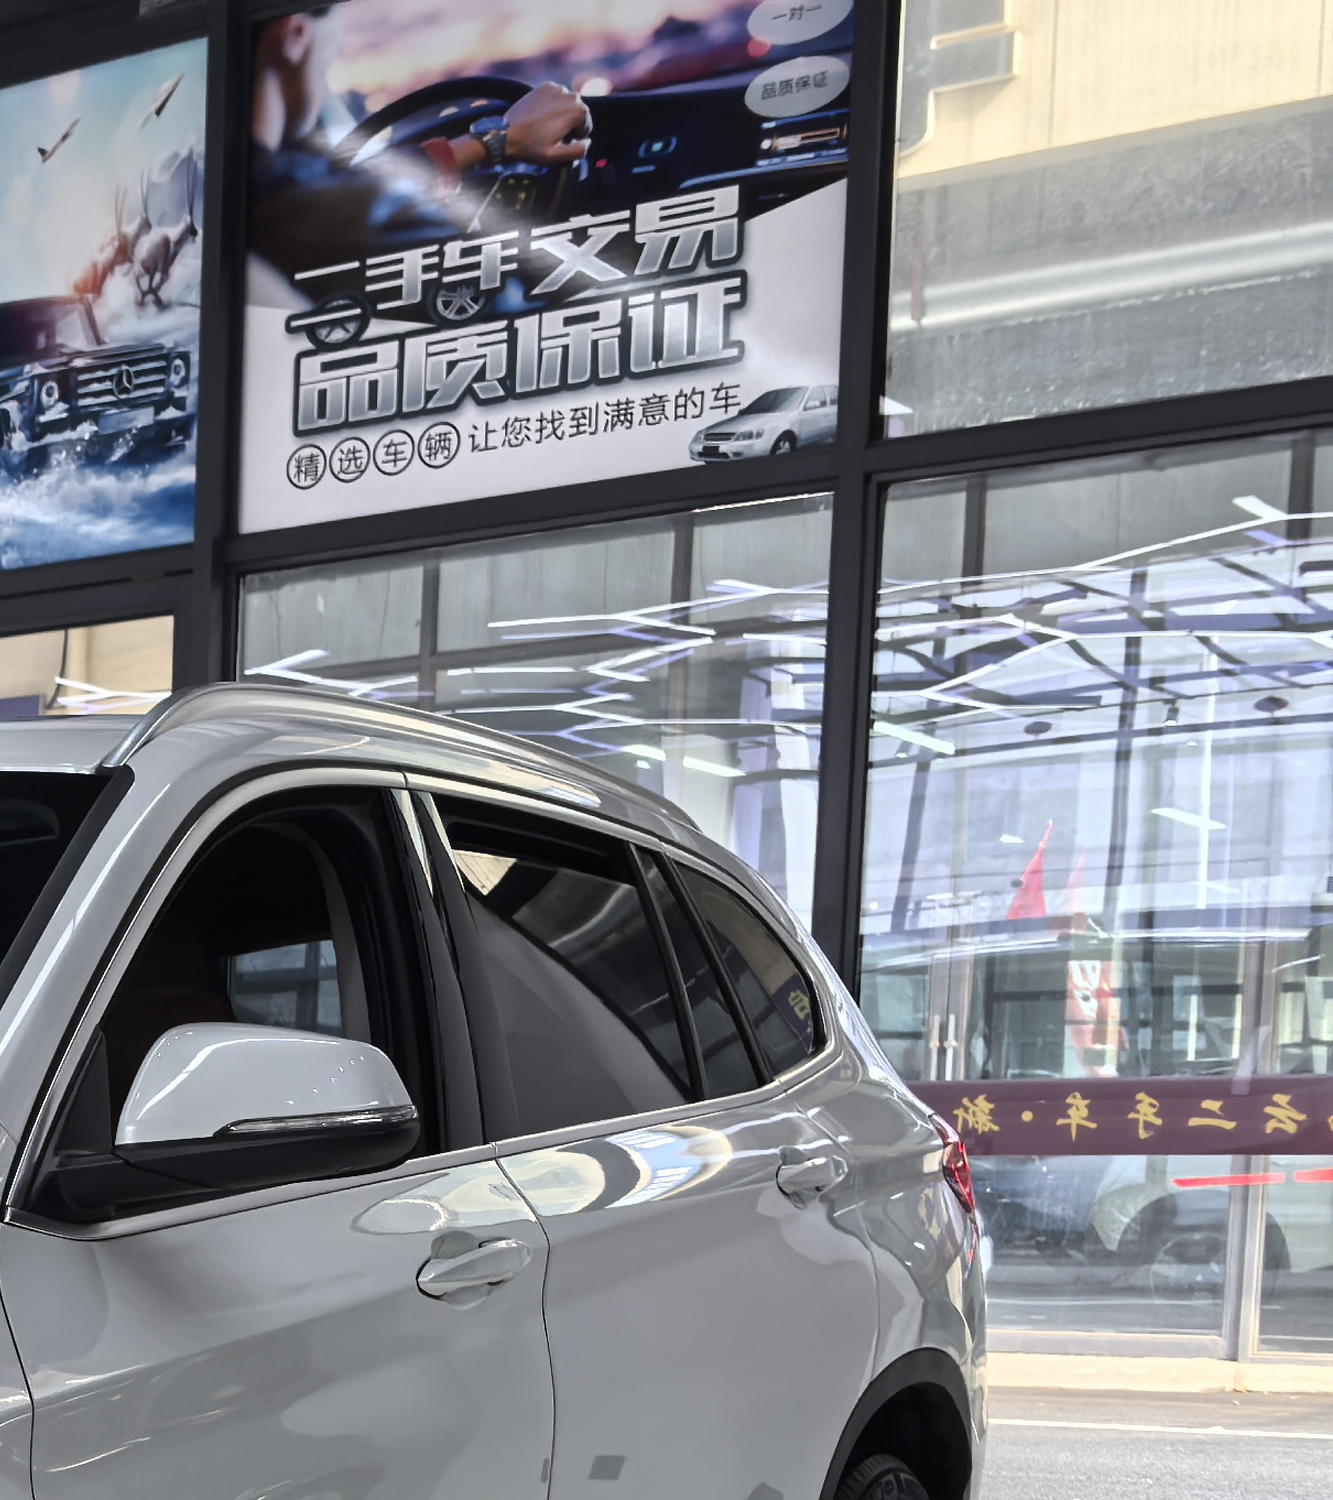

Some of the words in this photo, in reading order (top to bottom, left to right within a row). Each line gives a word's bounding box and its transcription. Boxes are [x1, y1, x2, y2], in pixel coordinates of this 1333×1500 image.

[760, 69, 829, 101] 品质保证
[289, 185, 742, 330] 二手车交易
[296, 277, 744, 433] 品质保证
[287, 420, 461, 490] 精选车辆
[468, 380, 742, 456] 让您找到满意的车
